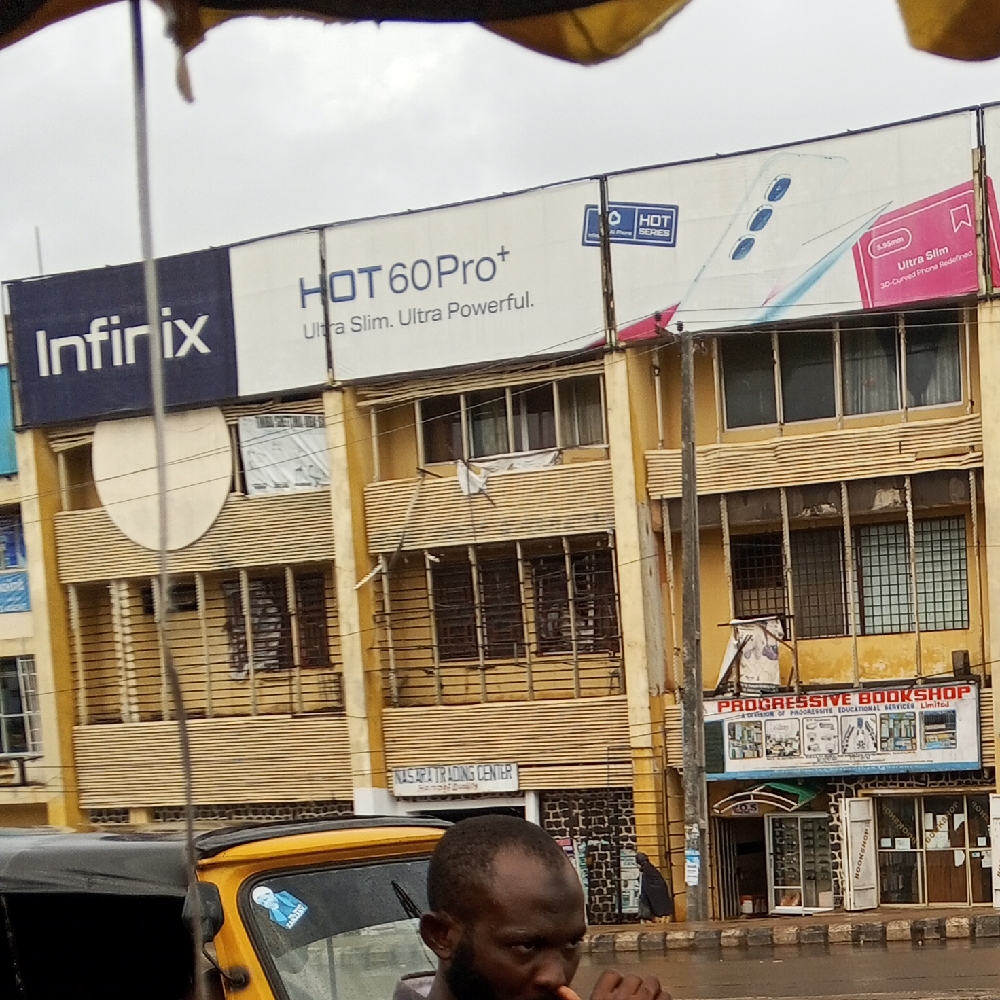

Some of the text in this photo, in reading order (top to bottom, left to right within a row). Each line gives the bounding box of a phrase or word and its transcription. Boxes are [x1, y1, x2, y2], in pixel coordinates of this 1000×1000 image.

[639, 214, 671, 227] HOT
[639, 228, 670, 236] SERIES
[897, 246, 949, 271] Ultra Slim
[916, 263, 939, 277] Phone
[938, 249, 974, 268] Redefined
[299, 265, 383, 308] HOT
[350, 315, 394, 333] Slim.
[398, 308, 442, 326] Ultra
[448, 290, 534, 320] Powerful.
[36, 307, 211, 376] Infinix
[717, 686, 971, 713] PROGRESSIVE BOOKSHOP
[838, 703, 881, 713] EDUCATIONAL
[920, 701, 950, 709] Limited
[477, 763, 513, 781] CENTER
